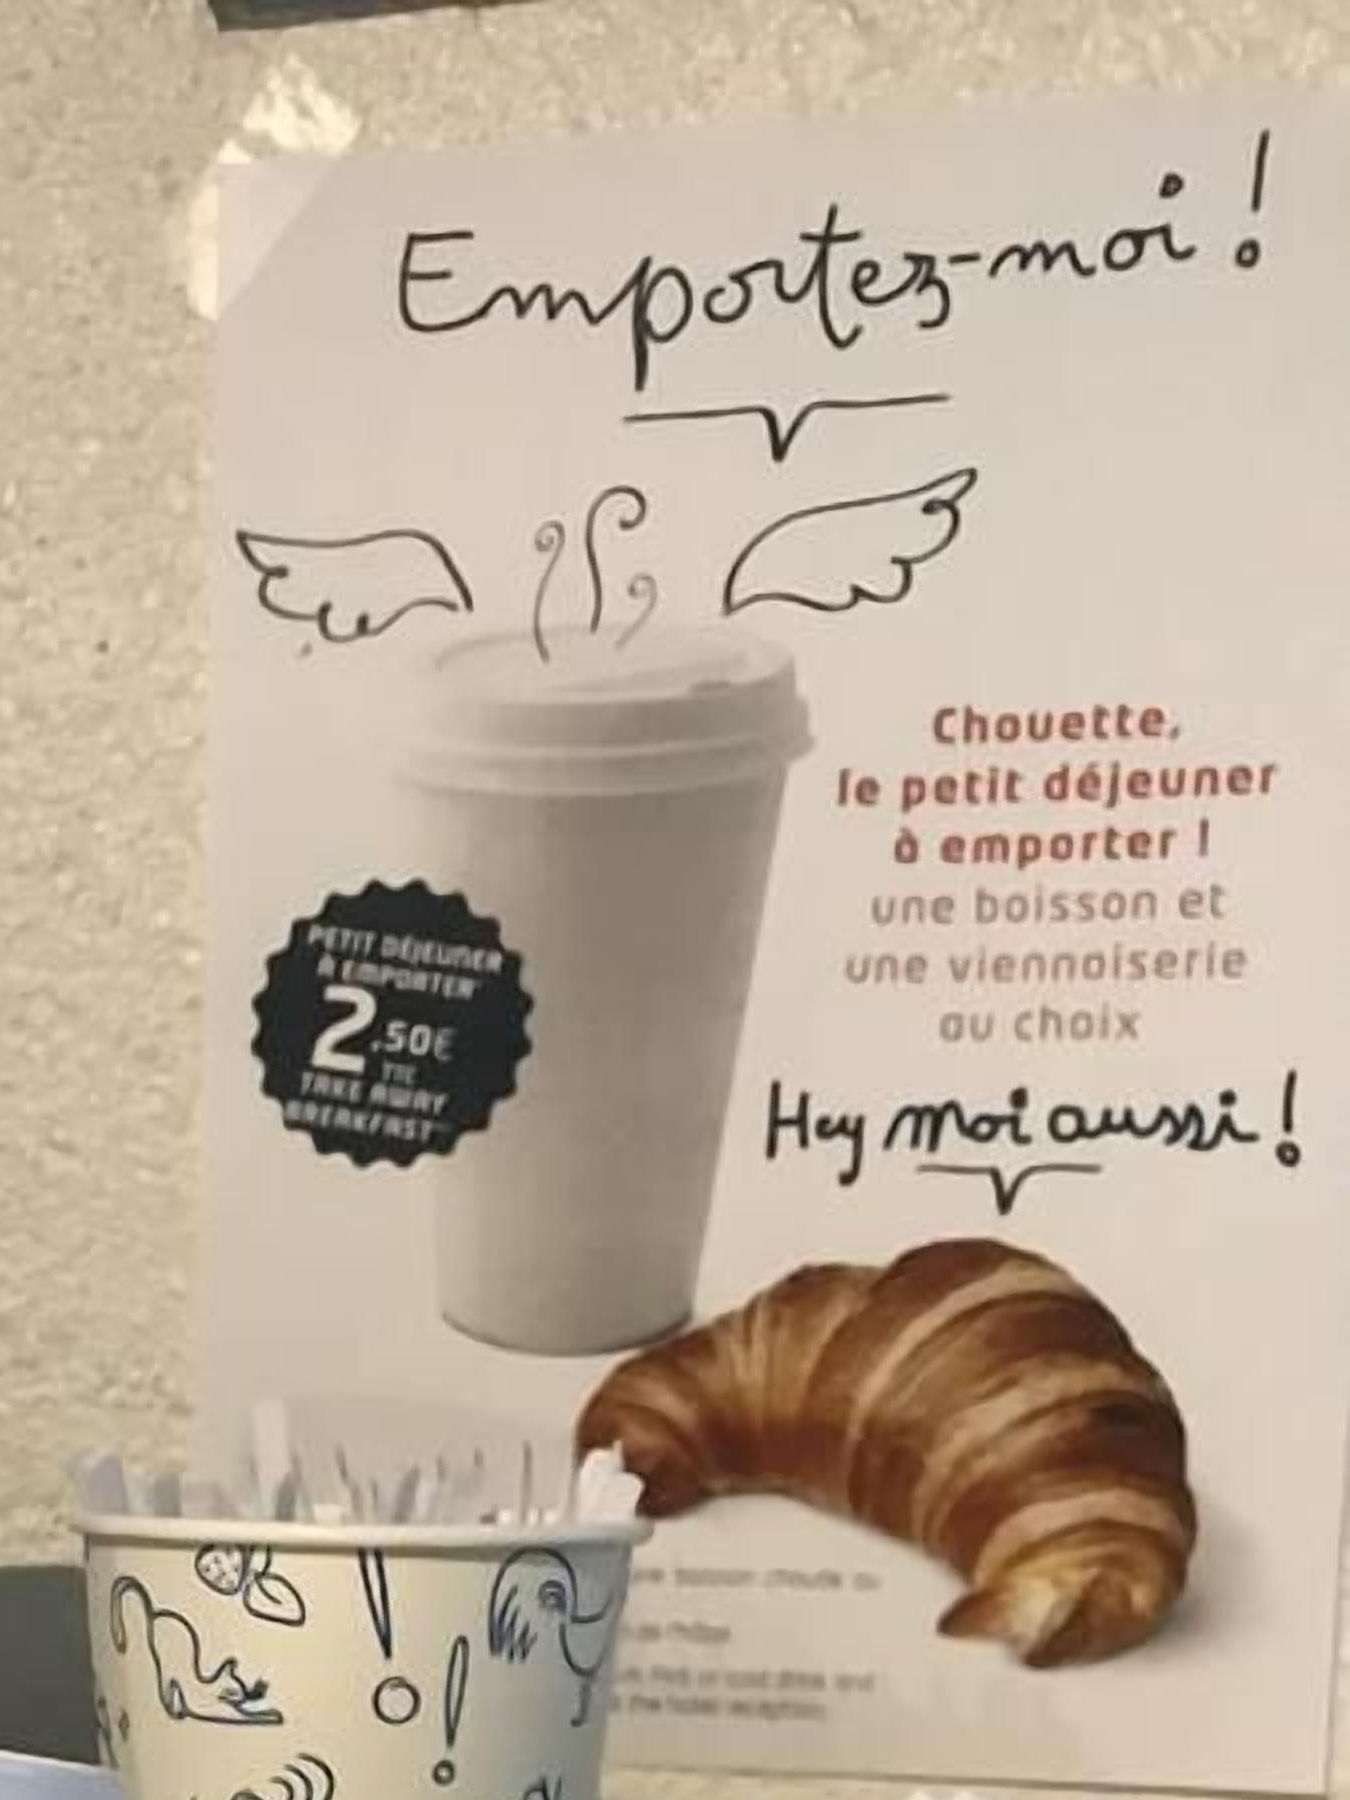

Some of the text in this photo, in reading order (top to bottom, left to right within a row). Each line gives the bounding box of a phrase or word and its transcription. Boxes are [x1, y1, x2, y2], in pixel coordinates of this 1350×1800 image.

[397, 169, 1198, 393] Emportez-moi
[932, 703, 1181, 745] Chouette,
[837, 760, 1277, 813] le petit déjeuner
[893, 826, 920, 865] à
[939, 825, 1178, 871] emporter
[871, 883, 1227, 927] une boisson et
[844, 941, 1248, 985] une viennoiserie
[938, 1003, 1142, 1043] au choix
[765, 1079, 866, 1187] Hey
[882, 1086, 1034, 1154] moi
[1047, 1089, 1261, 1152] aussi
